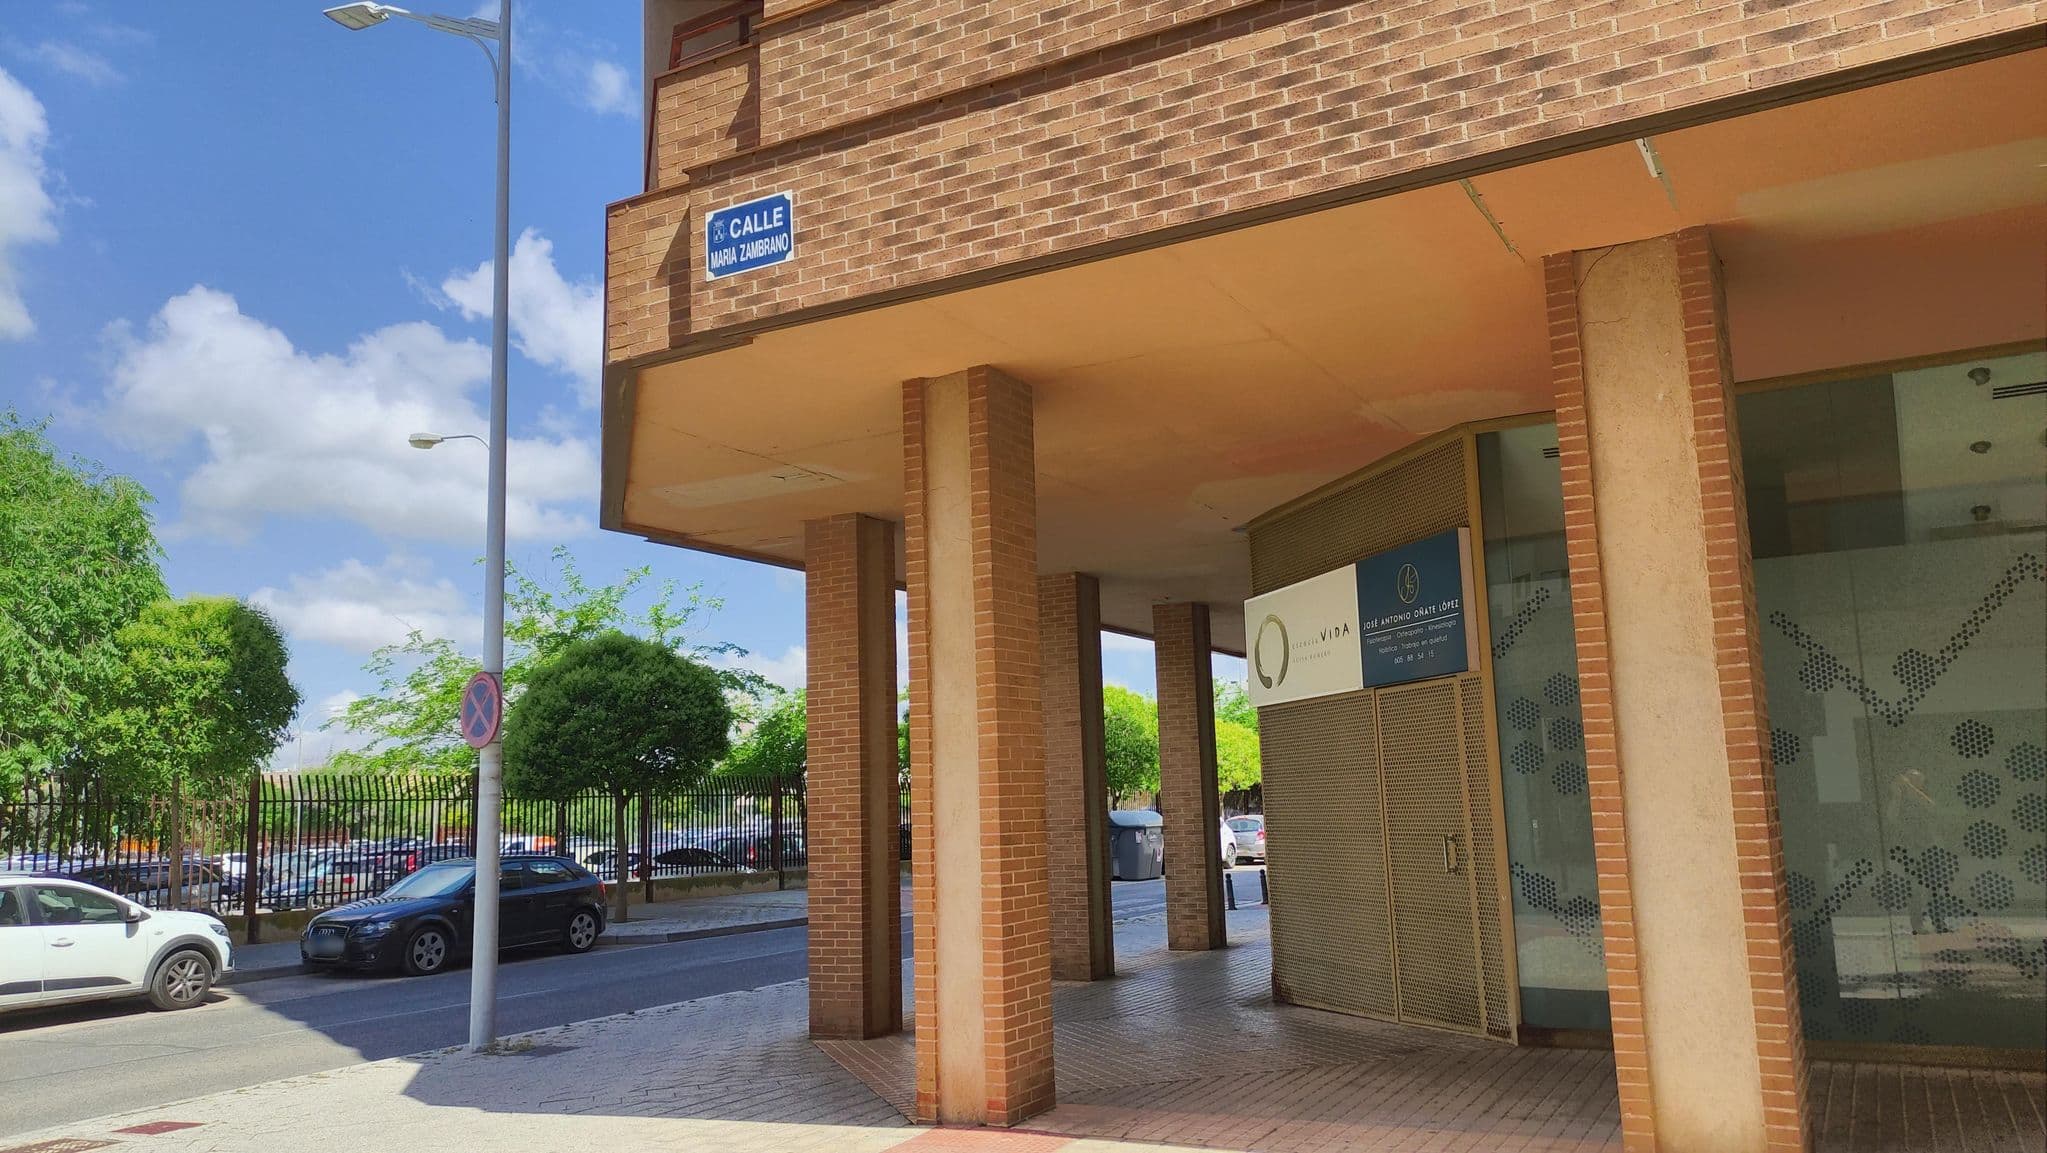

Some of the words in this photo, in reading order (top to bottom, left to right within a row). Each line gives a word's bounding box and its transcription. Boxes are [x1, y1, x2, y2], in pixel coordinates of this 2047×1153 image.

[730, 206, 783, 238] CALLE
[710, 246, 737, 270] MARIA
[740, 232, 788, 262] ZAMBRANO
[1381, 612, 1410, 624] ANTONIO
[1414, 606, 1436, 618] OÑATE
[1439, 599, 1459, 612] LÓPEZ
